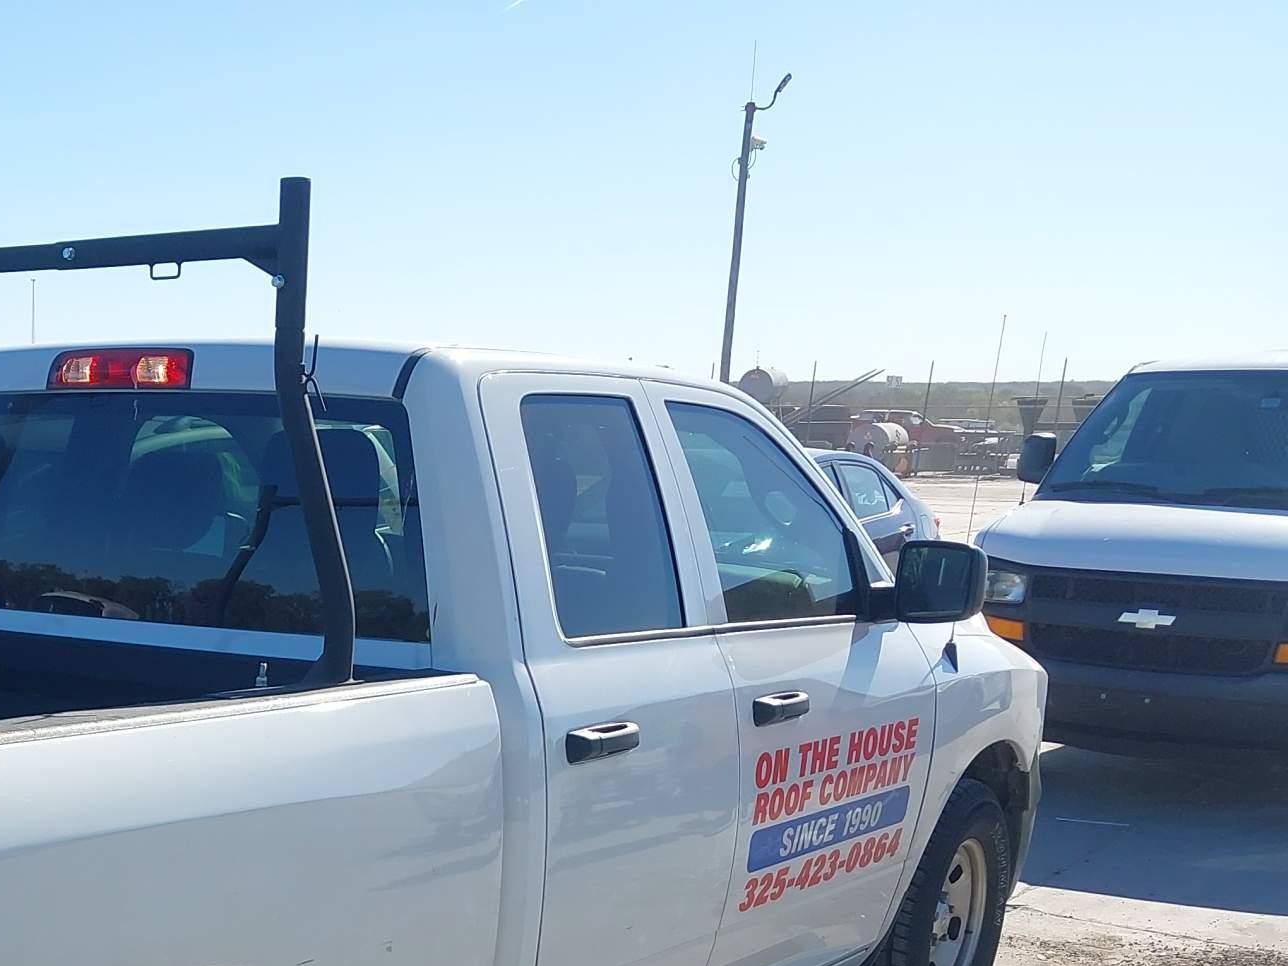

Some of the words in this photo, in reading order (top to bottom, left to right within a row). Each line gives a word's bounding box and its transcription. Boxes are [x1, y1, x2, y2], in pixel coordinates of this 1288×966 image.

[752, 779, 813, 826] ROOF
[818, 752, 916, 806] COMPANY
[755, 748, 790, 789] ON
[799, 736, 841, 777] THE
[847, 718, 919, 765] HOUSE
[779, 814, 837, 857] SINCE
[842, 801, 882, 836] 1990
[738, 828, 903, 912] 325-423-0864
